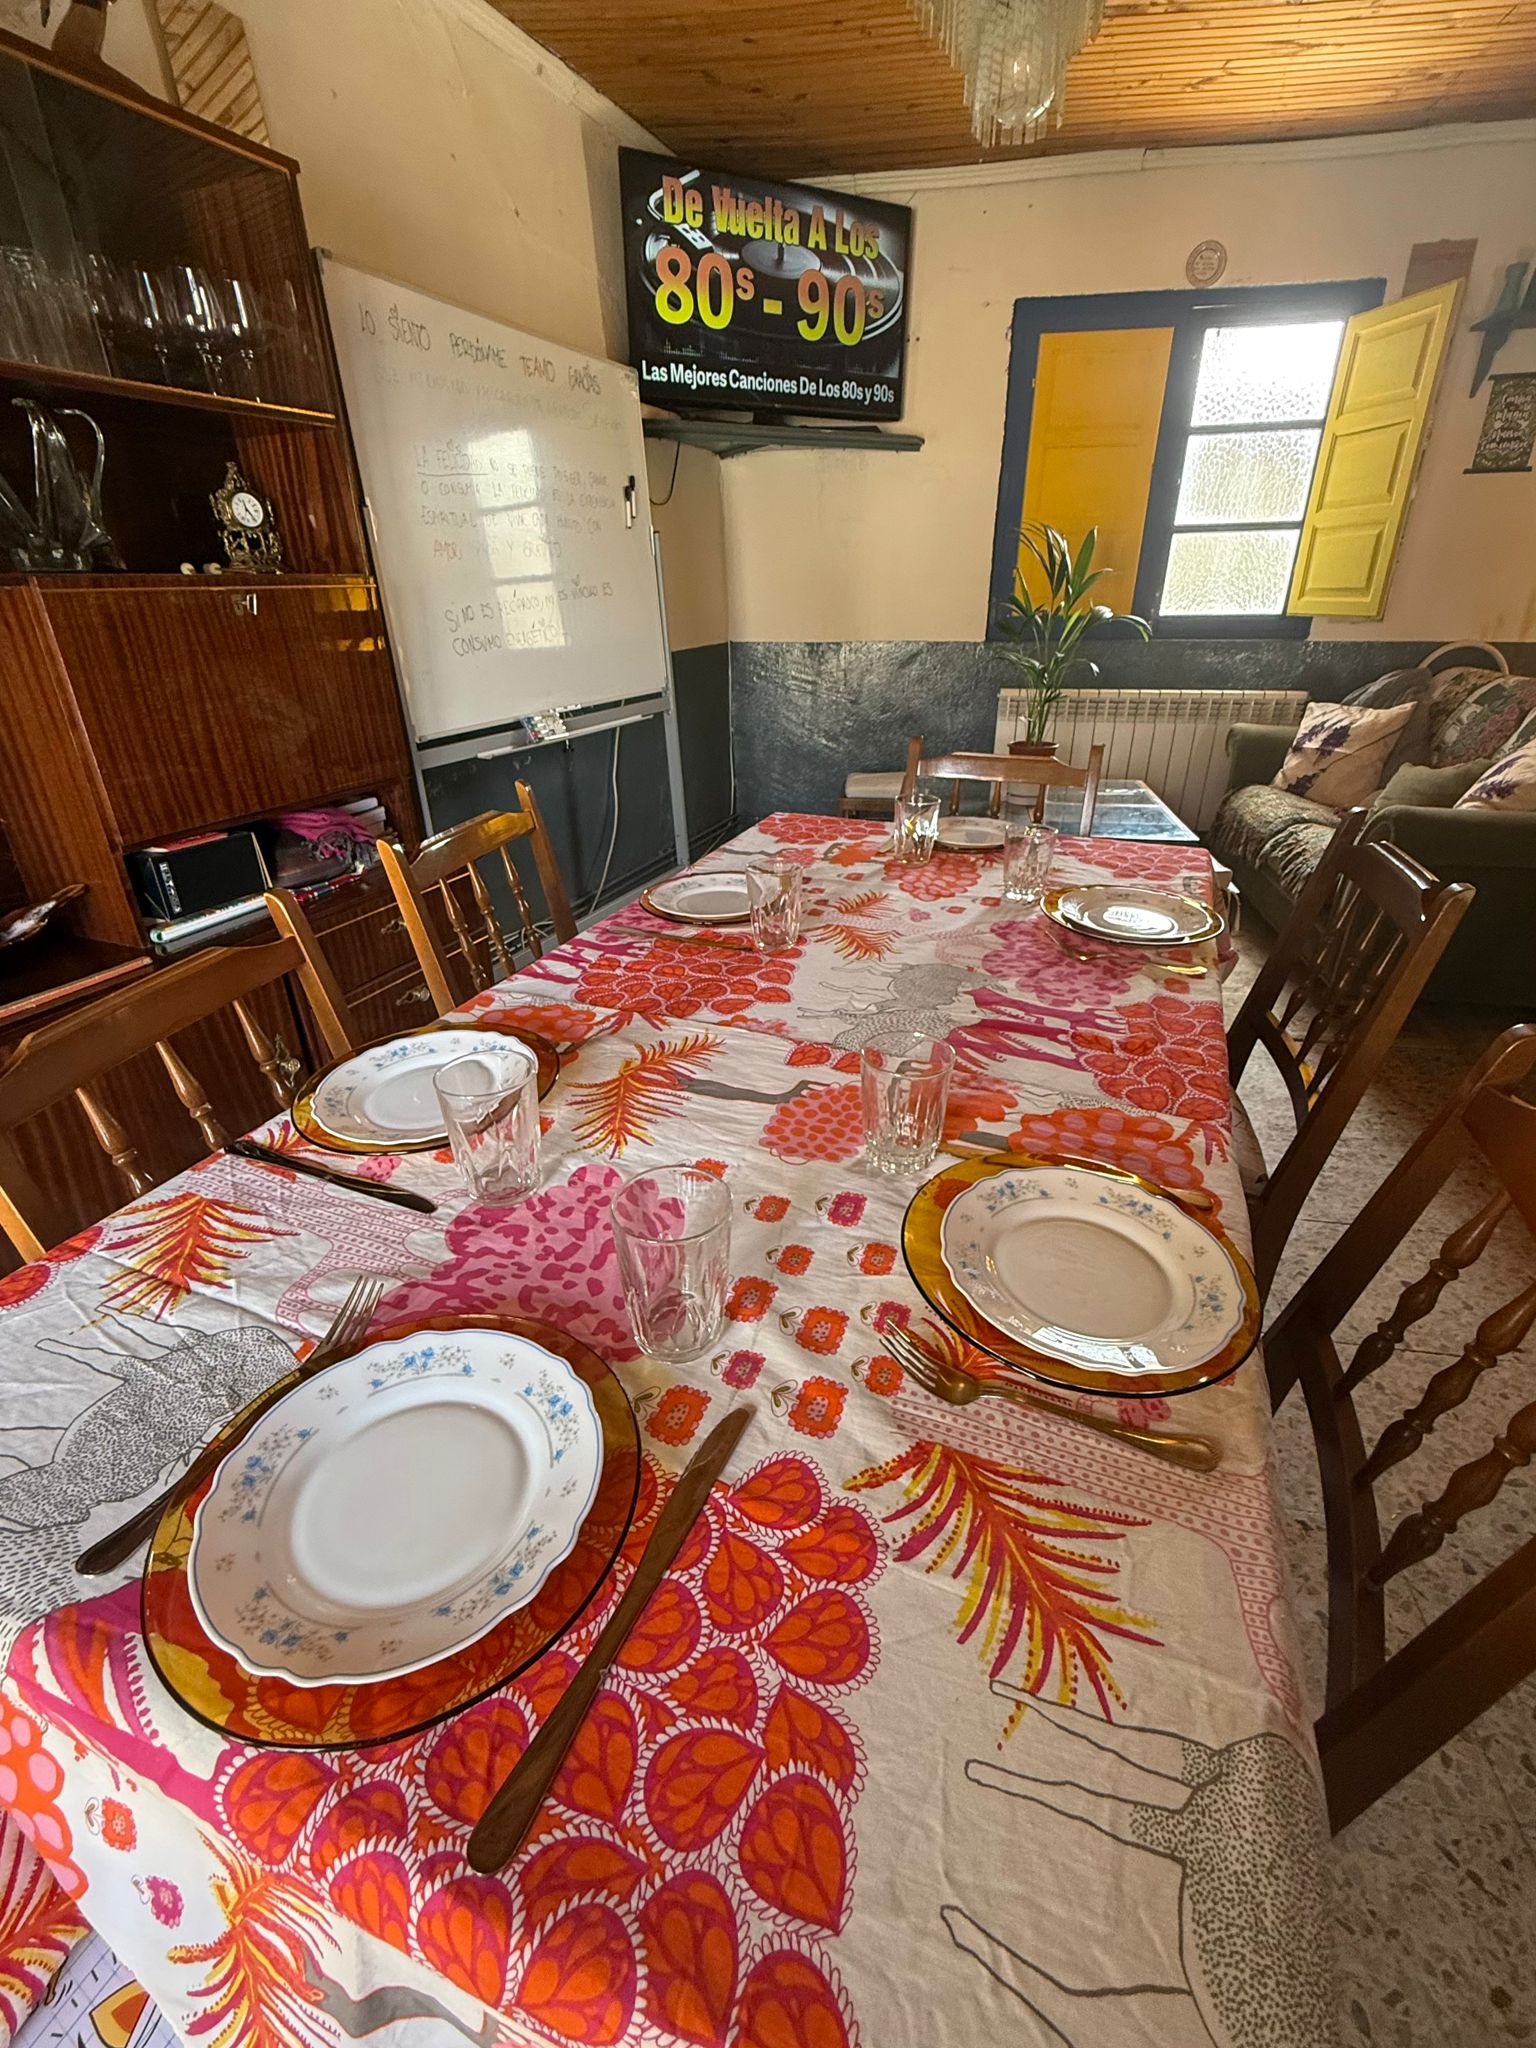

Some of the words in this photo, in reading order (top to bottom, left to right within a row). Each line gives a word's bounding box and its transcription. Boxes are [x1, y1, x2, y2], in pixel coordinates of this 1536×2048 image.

[662, 175, 704, 229] De
[711, 184, 800, 246] Vuelta
[807, 205, 828, 251] A
[834, 208, 880, 260] Los
[655, 246, 756, 330] 80s
[797, 268, 885, 347] 90s
[641, 359, 669, 382] Las
[670, 363, 727, 391] Mejores
[729, 368, 798, 396] Canciones
[799, 376, 817, 397] De
[818, 378, 840, 399] Los
[841, 380, 864, 402] 80s
[864, 386, 873, 406] y
[873, 384, 895, 404] 90s
